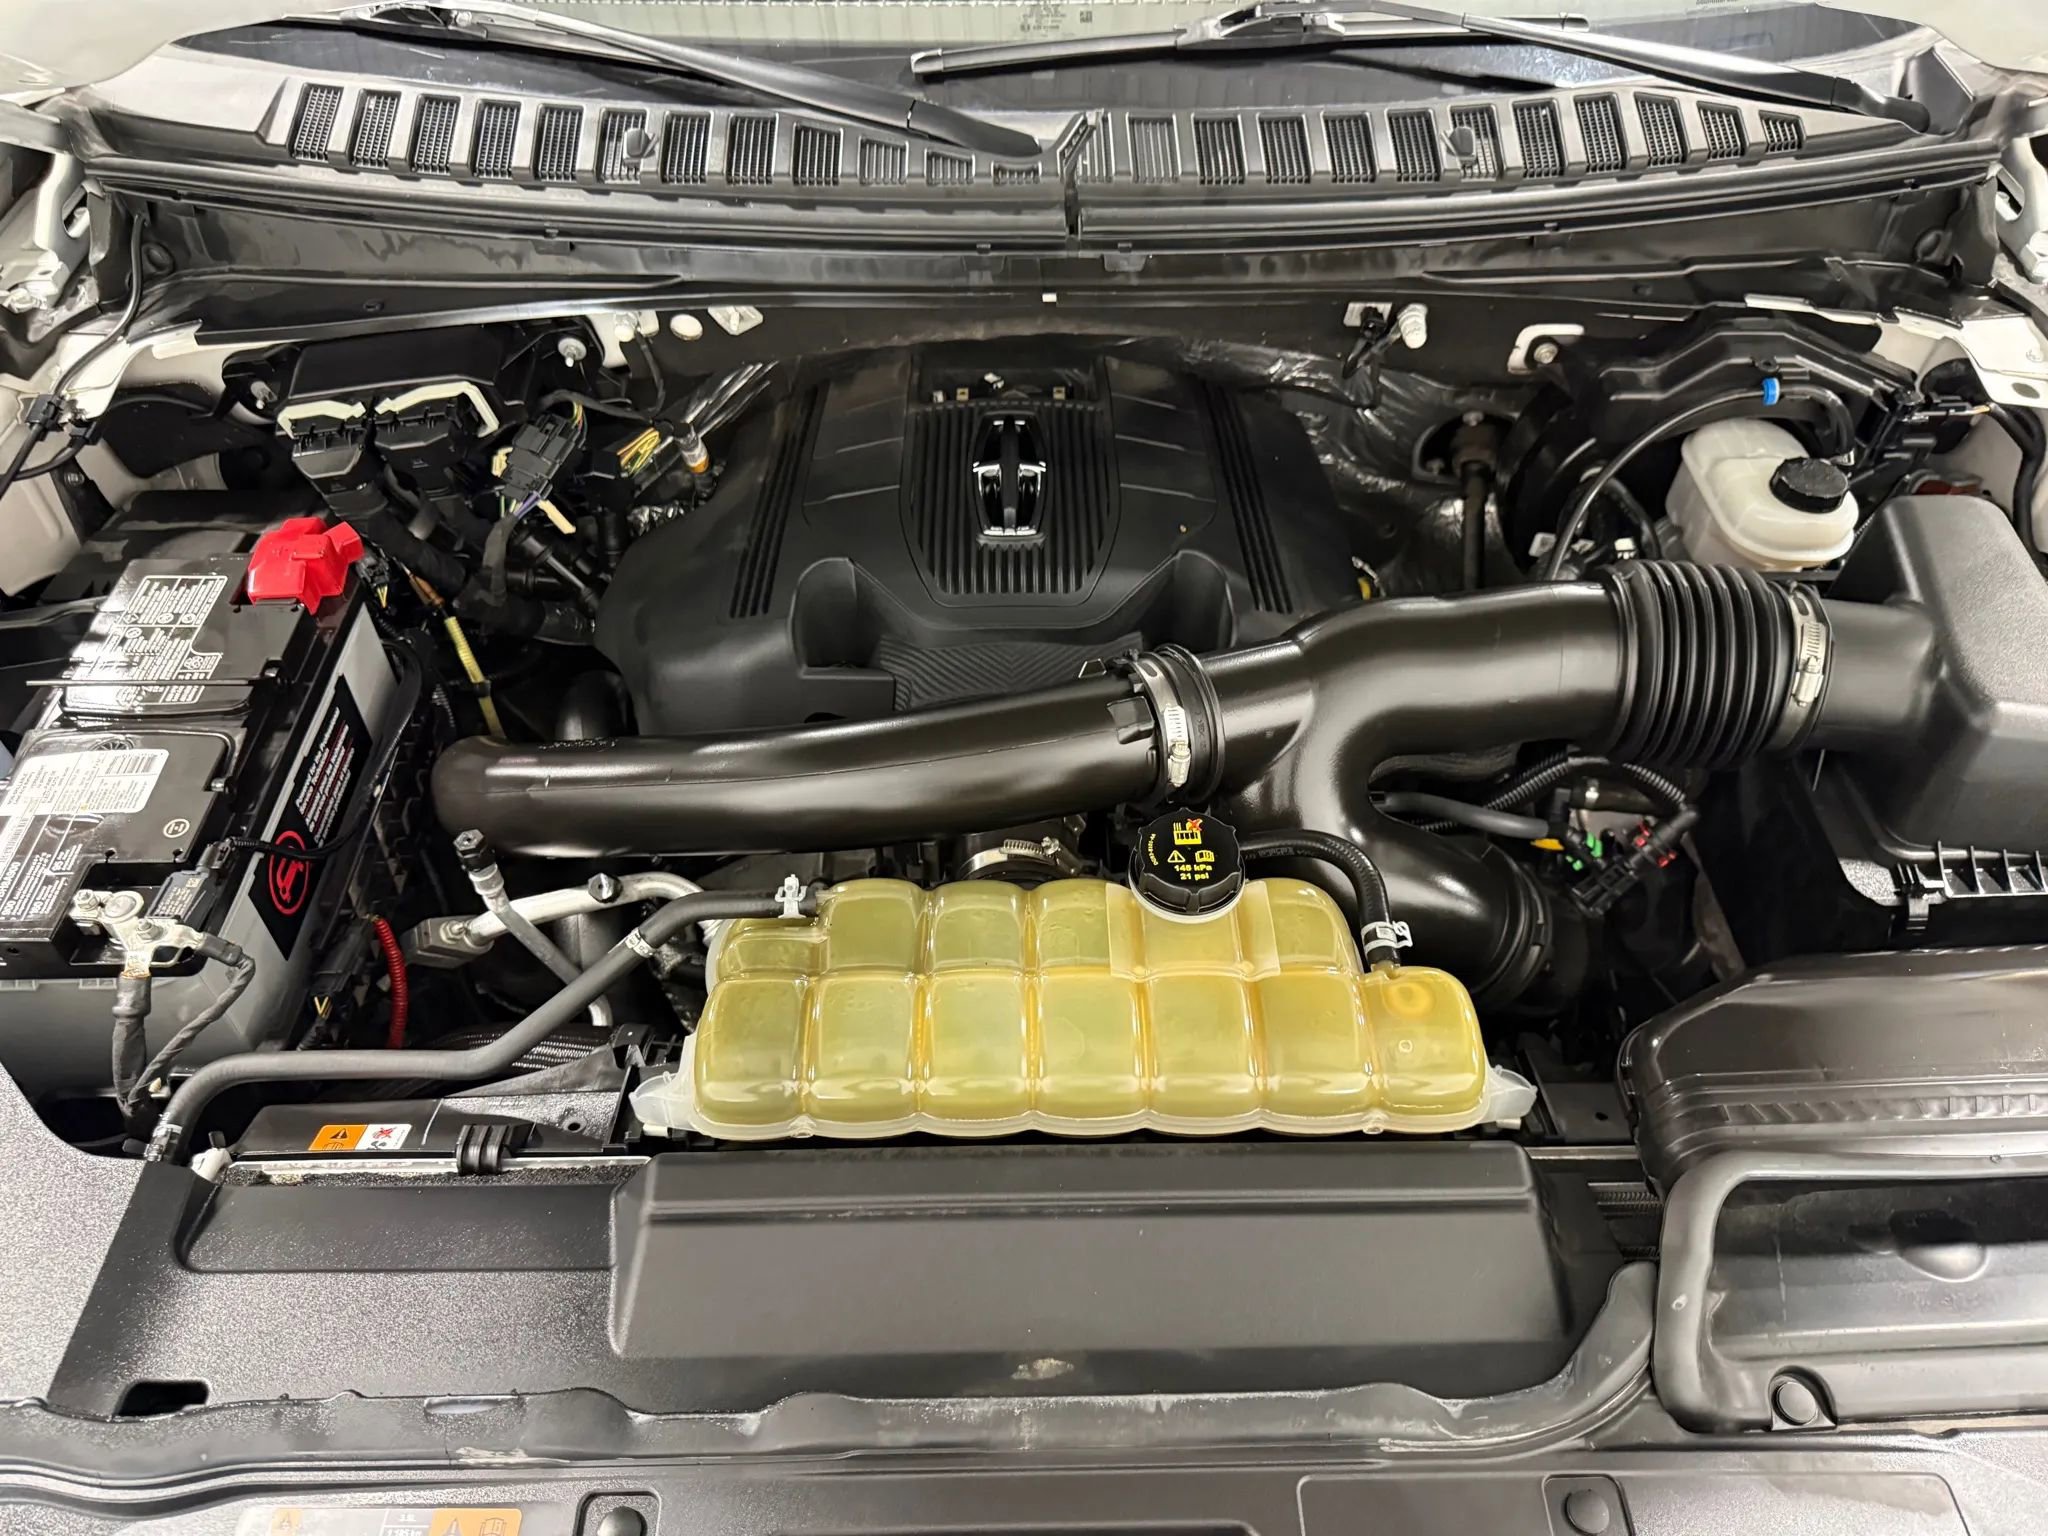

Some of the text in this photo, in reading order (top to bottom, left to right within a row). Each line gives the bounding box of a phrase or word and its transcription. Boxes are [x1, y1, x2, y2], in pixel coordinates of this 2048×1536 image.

[296, 773, 312, 807] Powered
[320, 706, 340, 752] Professional
[300, 785, 314, 815] Service
[1180, 872, 1210, 881] 21 psi
